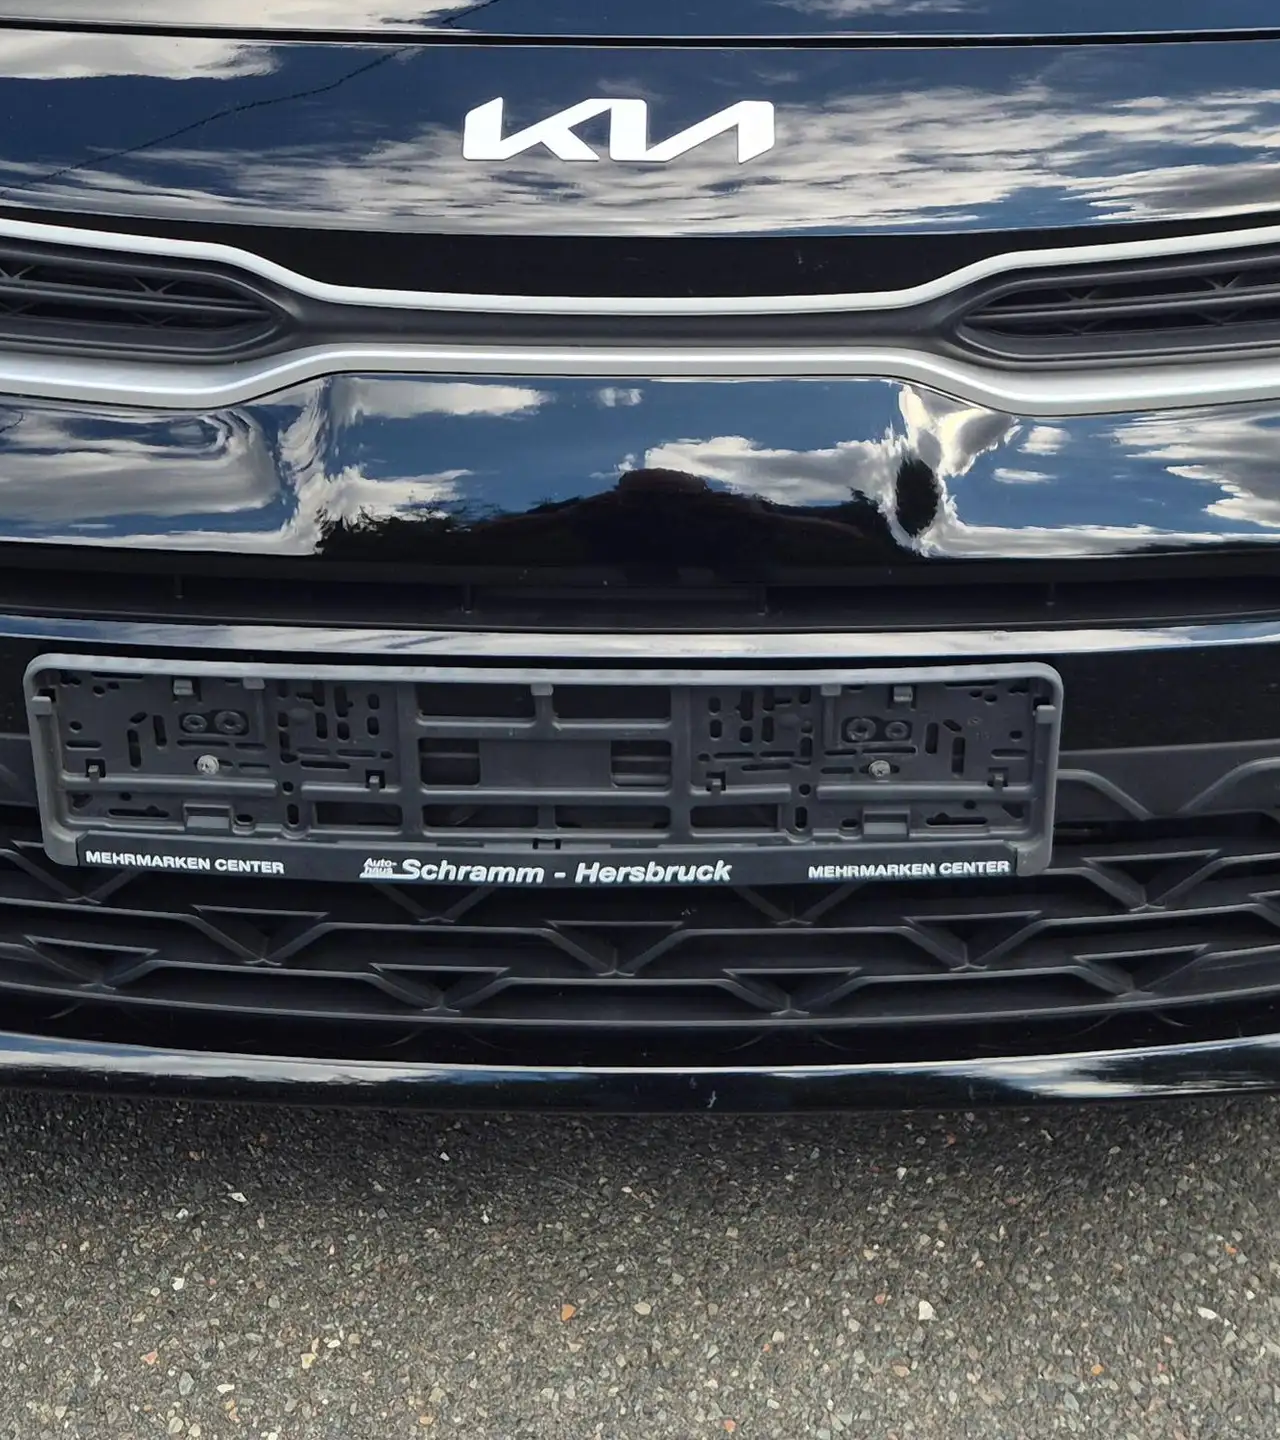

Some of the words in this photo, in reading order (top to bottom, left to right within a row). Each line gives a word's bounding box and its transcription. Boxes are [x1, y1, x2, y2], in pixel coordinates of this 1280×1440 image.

[463, 97, 774, 164] KIA
[85, 850, 211, 871] MEHRMARKEN
[214, 858, 285, 874] CENTER
[363, 857, 398, 868] Auto-
[402, 859, 545, 884] Schramm
[575, 860, 733, 884] Hersbruck
[808, 863, 936, 879] MEHRMARKEN
[939, 860, 1010, 876] CENTER
